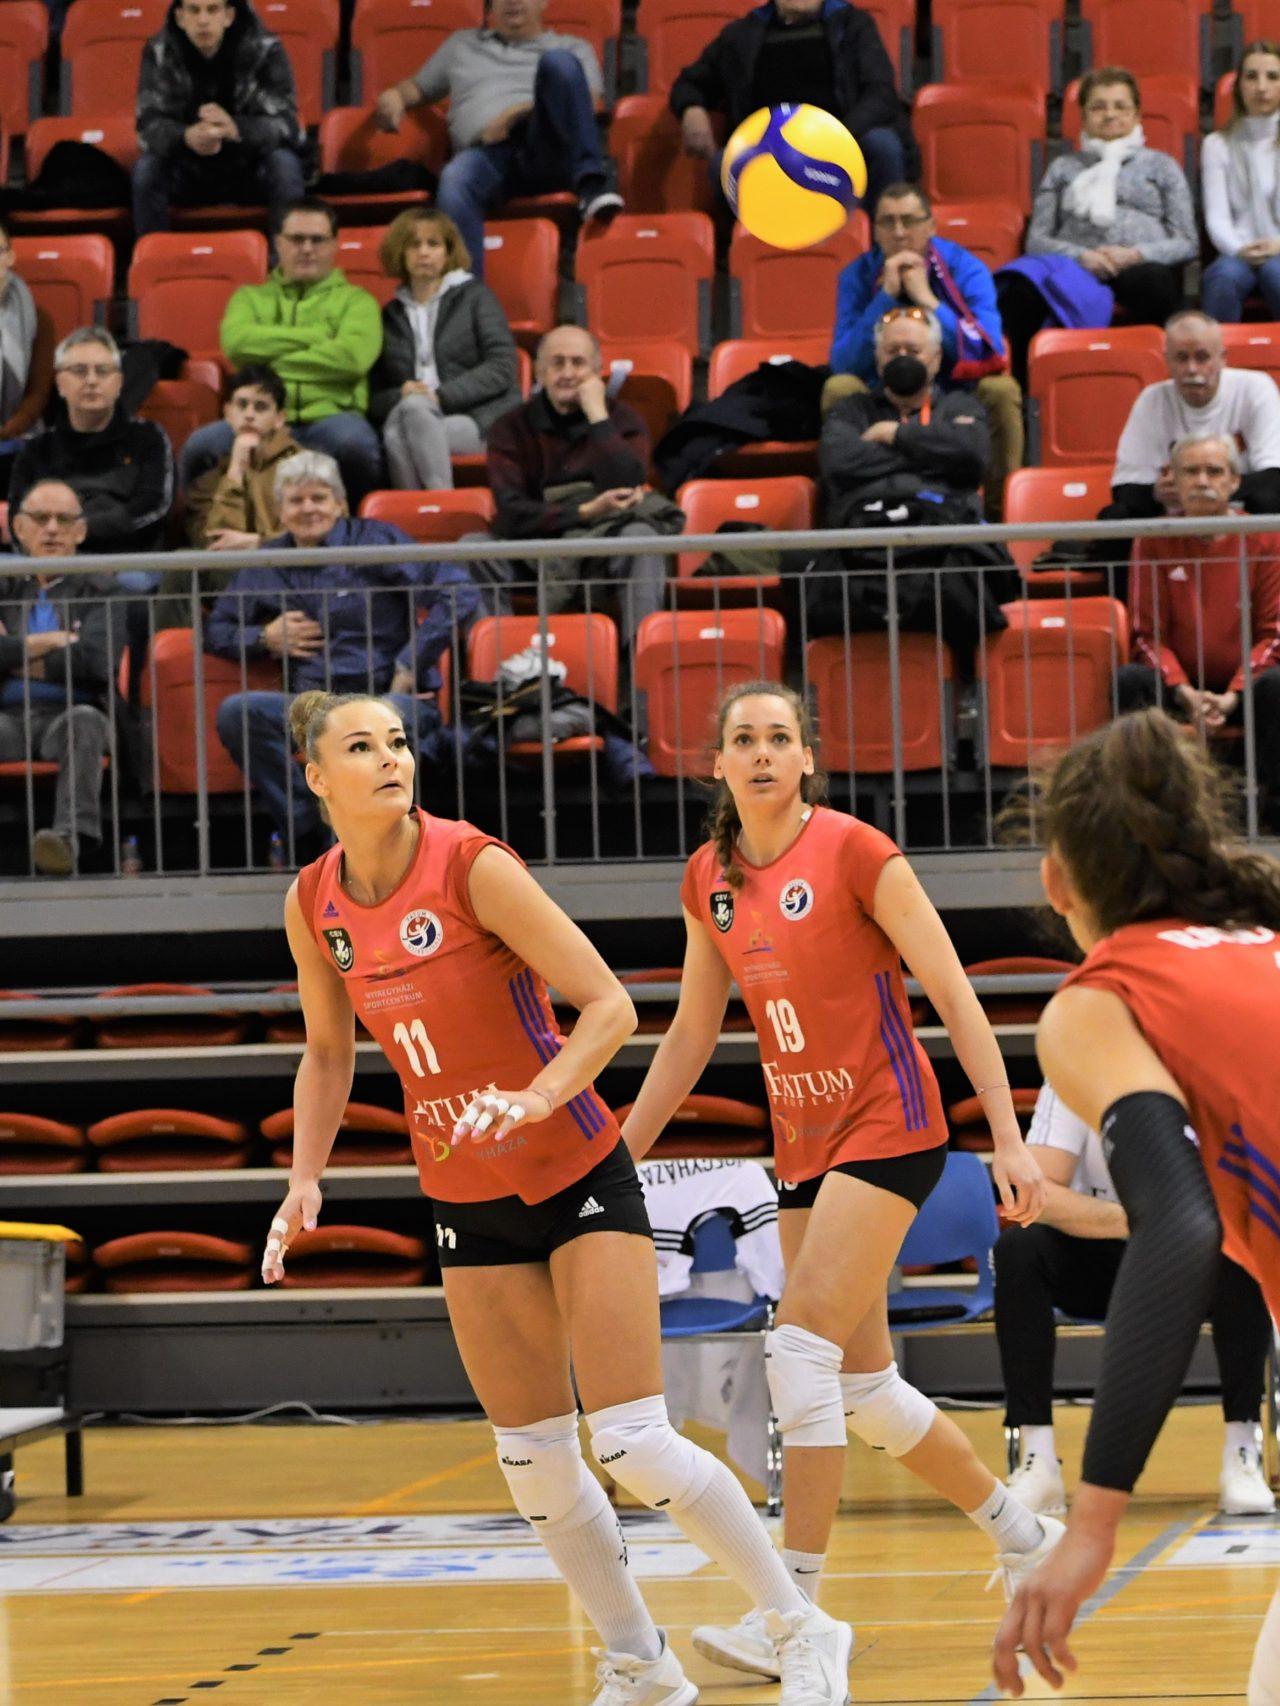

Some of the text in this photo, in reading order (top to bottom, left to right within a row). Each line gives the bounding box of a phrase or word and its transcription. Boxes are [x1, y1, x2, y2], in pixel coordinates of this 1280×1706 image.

[393, 1018, 441, 1078] 11
[766, 998, 806, 1053] 19
[762, 1060, 854, 1099] FATUM
